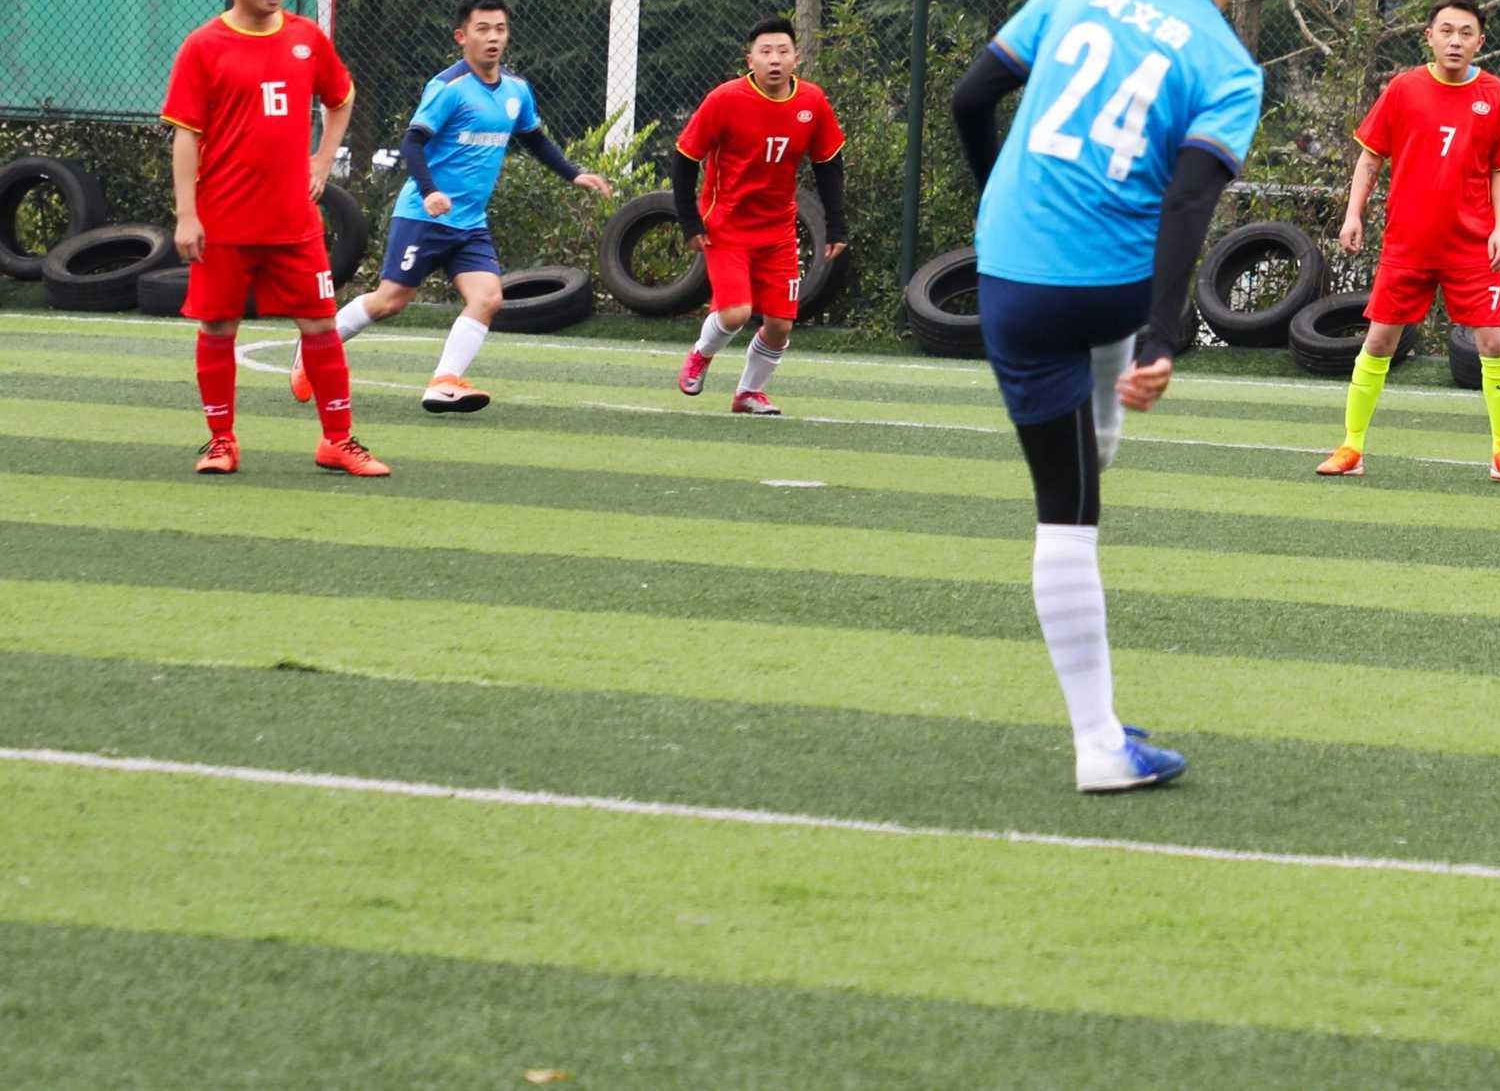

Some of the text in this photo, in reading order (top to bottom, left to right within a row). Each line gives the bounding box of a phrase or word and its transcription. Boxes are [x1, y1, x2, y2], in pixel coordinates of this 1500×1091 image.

[260, 81, 288, 117] 16
[1027, 21, 1172, 183] 24
[765, 136, 790, 163] 17
[1439, 125, 1457, 158] 7
[400, 245, 420, 271] 5
[316, 270, 335, 299] 16
[1488, 285, 1500, 311] 7
